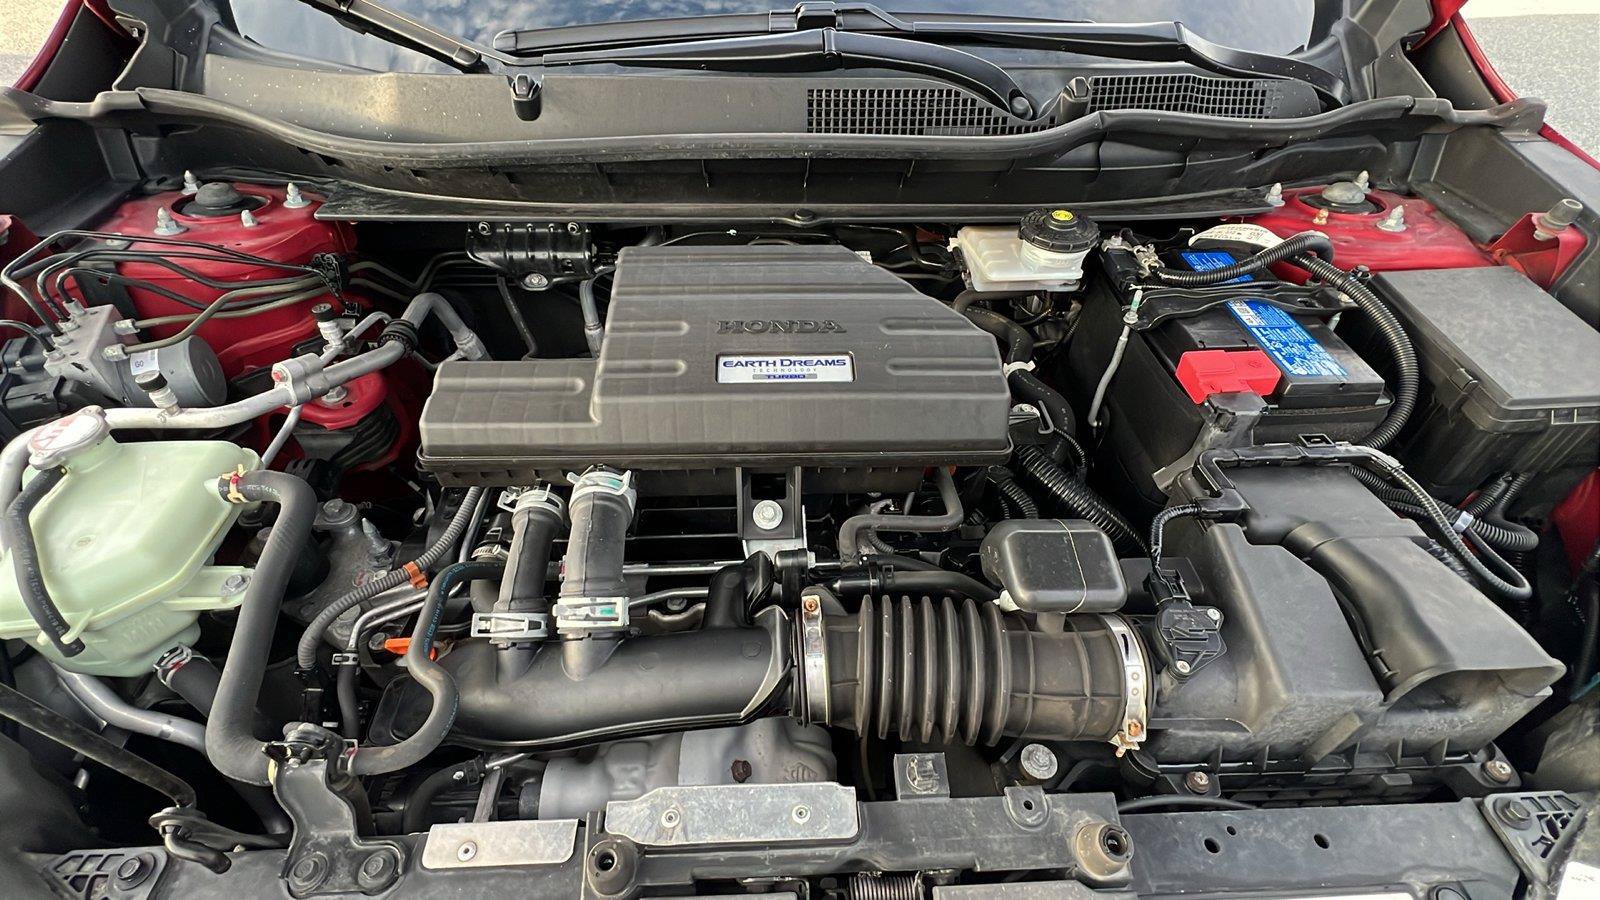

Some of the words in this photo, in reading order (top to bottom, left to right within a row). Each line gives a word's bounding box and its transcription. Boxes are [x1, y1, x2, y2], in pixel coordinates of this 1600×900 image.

[716, 320, 847, 334] HONDA
[723, 360, 777, 368] EARTH
[780, 359, 846, 367] DREAMS
